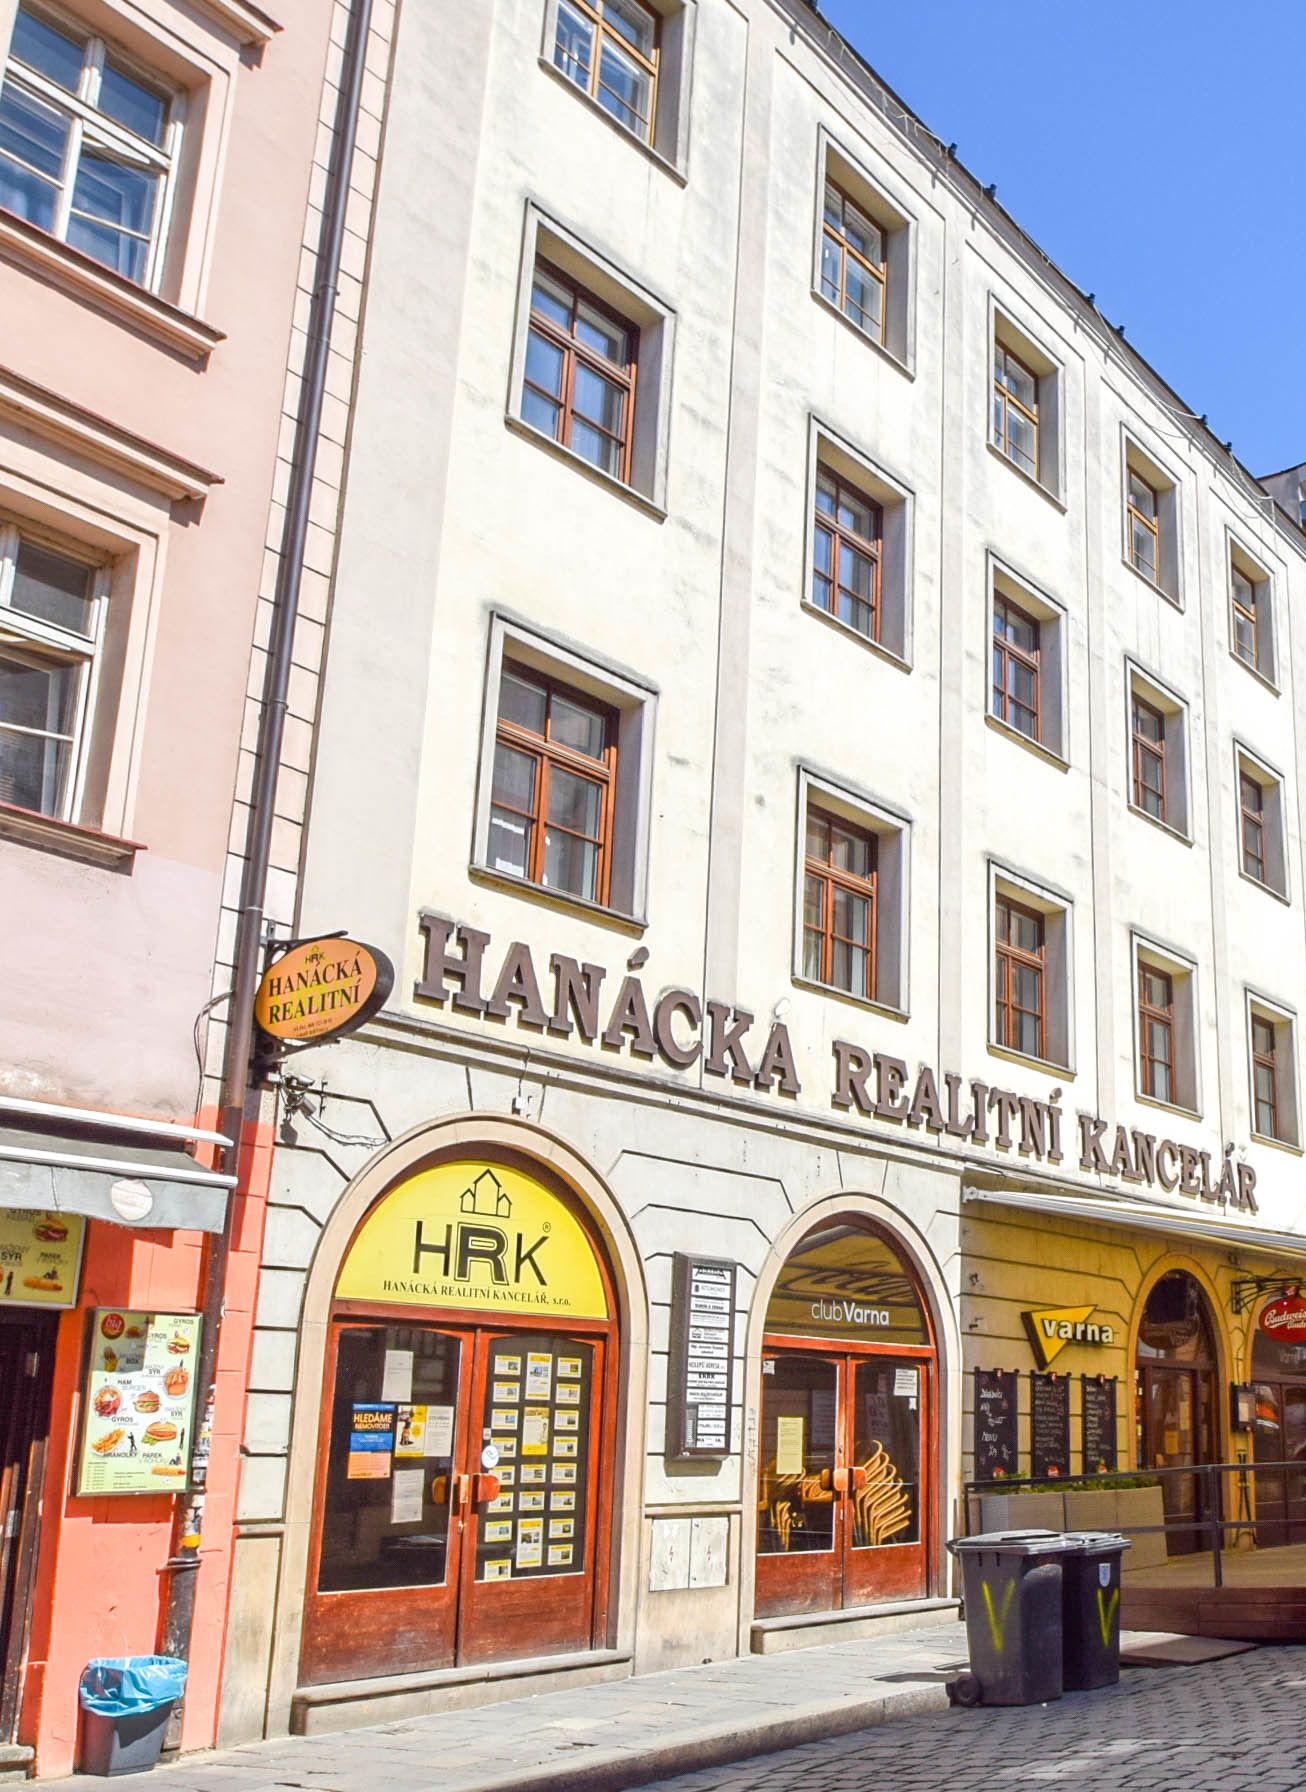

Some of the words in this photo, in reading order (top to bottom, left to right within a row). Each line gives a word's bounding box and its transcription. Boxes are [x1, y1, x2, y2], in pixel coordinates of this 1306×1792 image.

[268, 951, 362, 997] HANÁCKÁ
[304, 951, 326, 965] HRK
[268, 978, 362, 1025] REALITNÍ
[831, 1039, 1063, 1161] REALITNÍ
[412, 1220, 550, 1287] HRK
[383, 1279, 438, 1296] HANÁCKÁ
[440, 1285, 491, 1300] REALITNÍ
[552, 1297, 572, 1307] s.r.o.
[1043, 1318, 1115, 1344] varna
[353, 1411, 394, 1424] HLEDÁME
